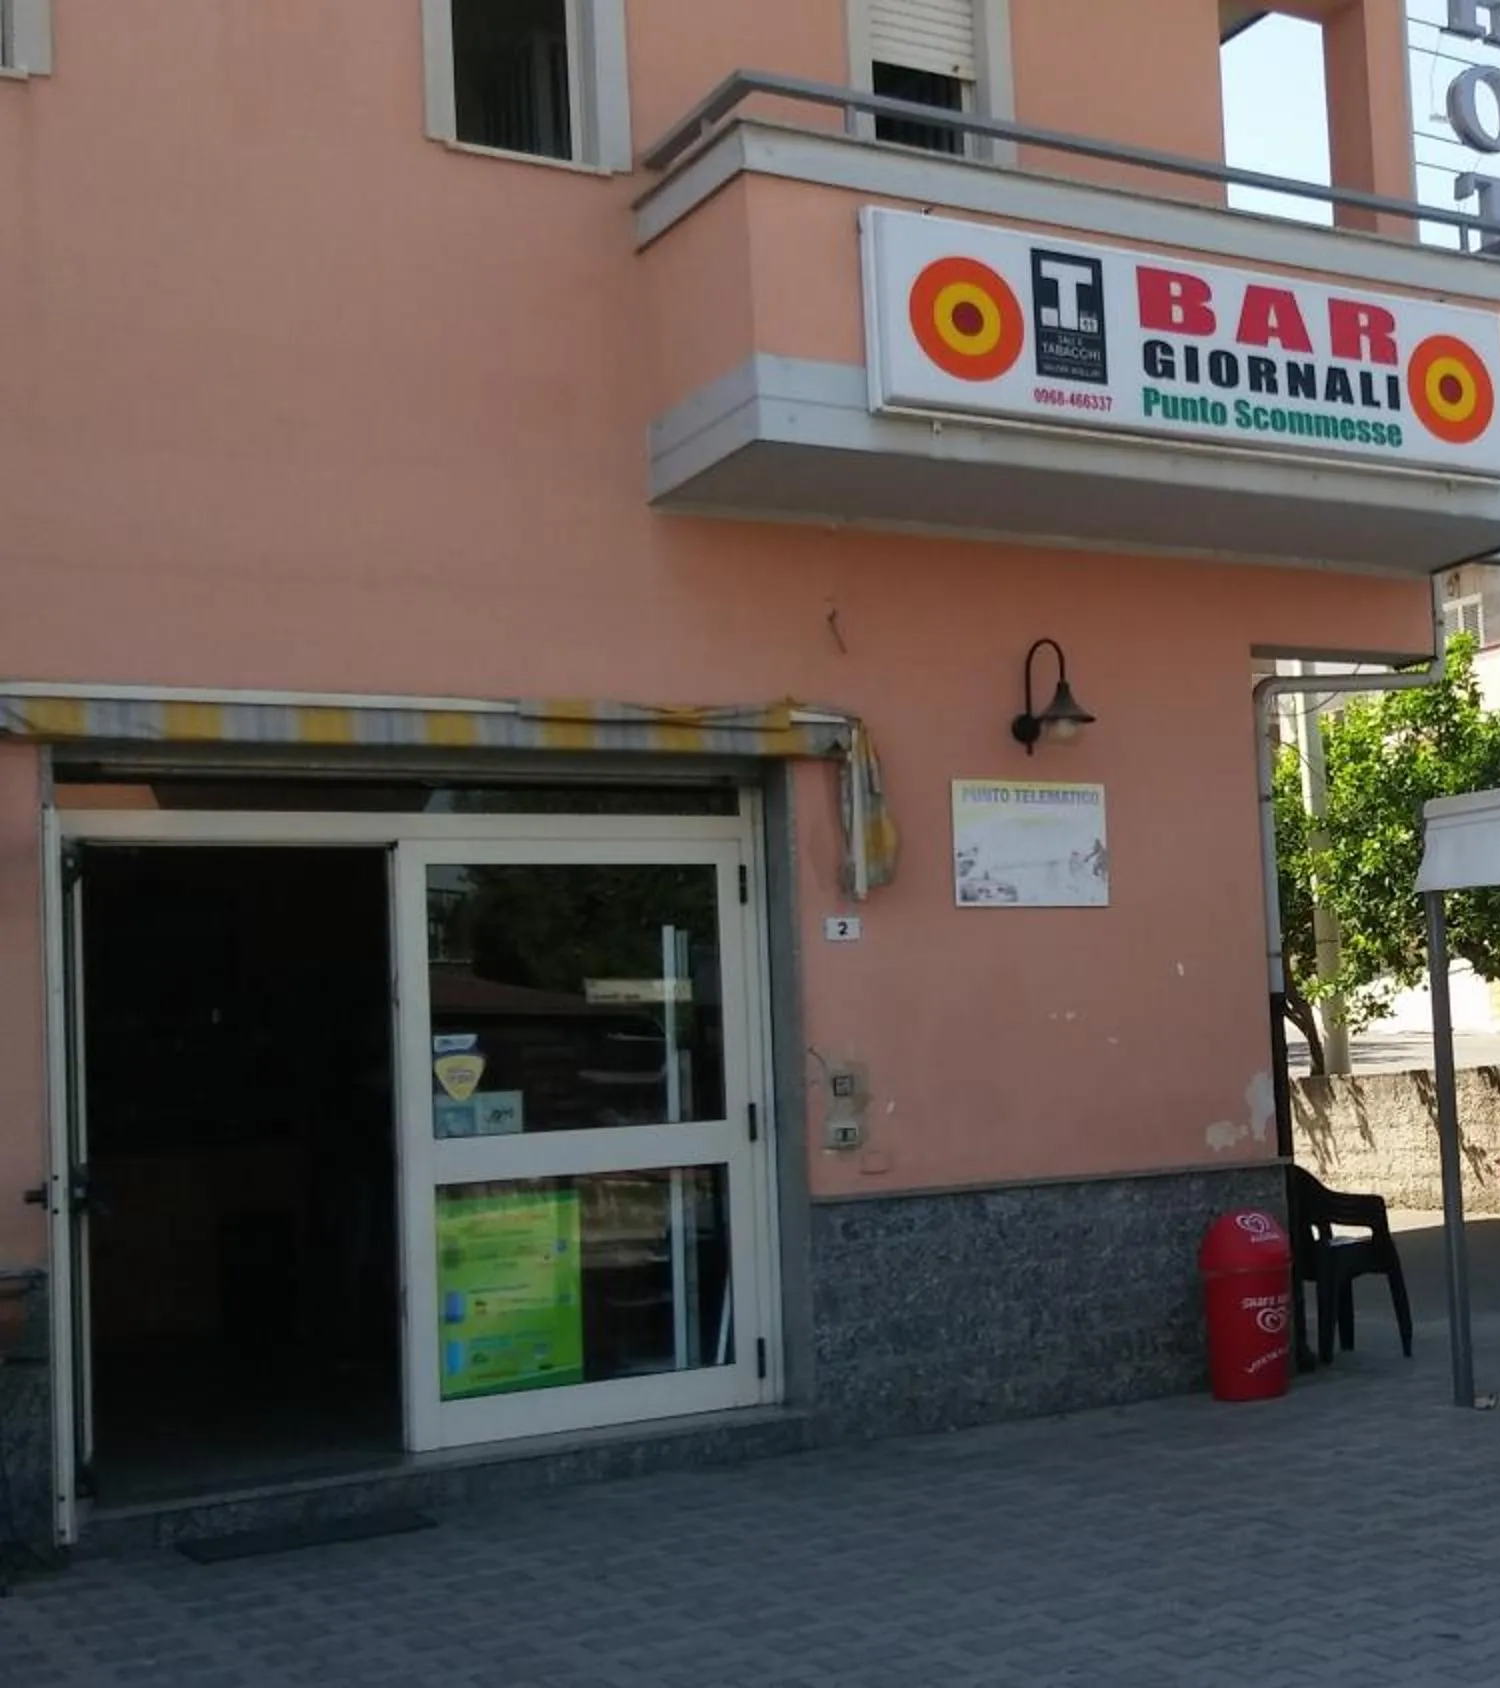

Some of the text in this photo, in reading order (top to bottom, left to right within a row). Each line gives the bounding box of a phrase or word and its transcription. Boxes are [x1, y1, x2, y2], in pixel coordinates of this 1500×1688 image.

[1136, 265, 1399, 366] BAR
[1142, 339, 1401, 412] GIORNALI
[1142, 387, 1403, 448] Punto Scommesse
[962, 787, 1009, 803] PUNTO
[837, 921, 849, 937] 2
